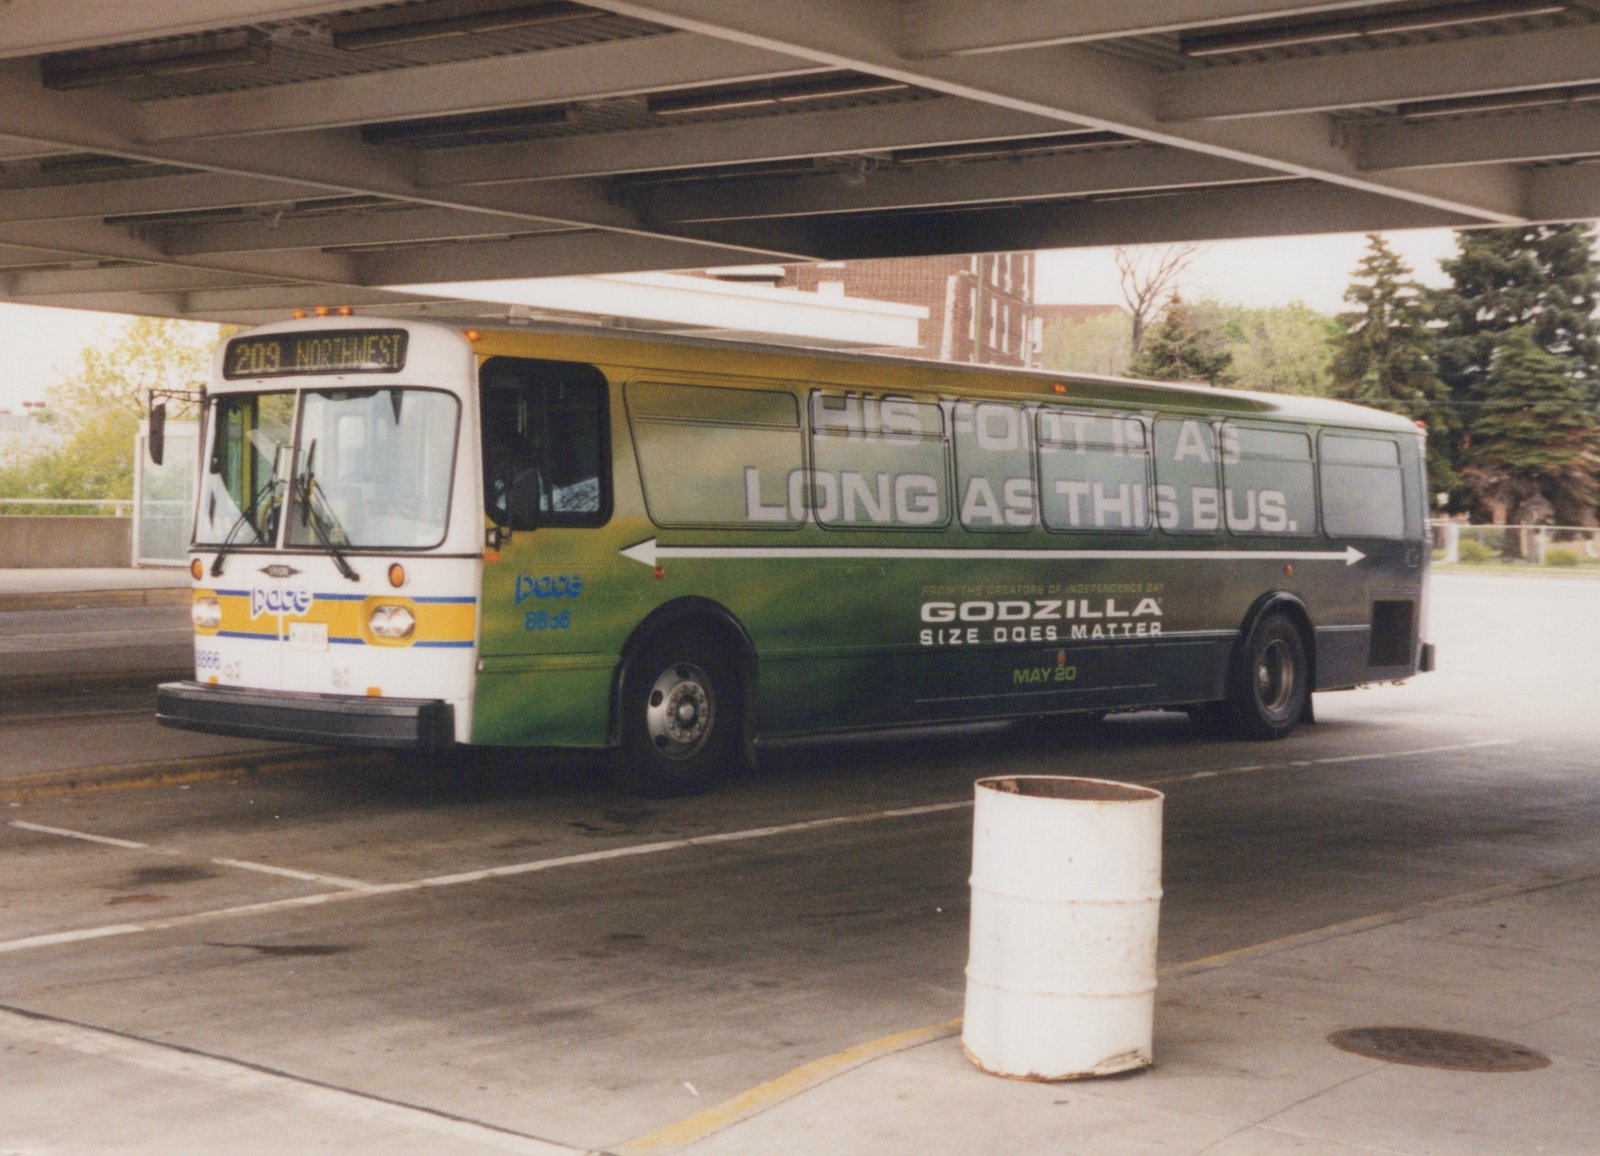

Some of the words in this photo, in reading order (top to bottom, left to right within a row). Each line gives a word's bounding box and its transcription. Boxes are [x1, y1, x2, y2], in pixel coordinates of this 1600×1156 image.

[233, 341, 281, 373] 209
[296, 335, 401, 371] NORTHWEST
[810, 388, 924, 447] HIS
[1111, 410, 1154, 459] IS
[1173, 419, 1241, 465] AS
[745, 466, 940, 524] LONG
[961, 476, 1037, 526] AS
[1056, 480, 1180, 529] THIS
[1192, 486, 1298, 532] BUS.
[251, 588, 311, 616] pace
[515, 575, 582, 604] pace
[921, 598, 1163, 622] GODZILLA
[920, 628, 980, 646] SIZE
[994, 625, 1058, 643] DOES
[1071, 622, 1162, 639] MATTER
[1013, 667, 1052, 684] MAY
[1054, 665, 1077, 682] 20
